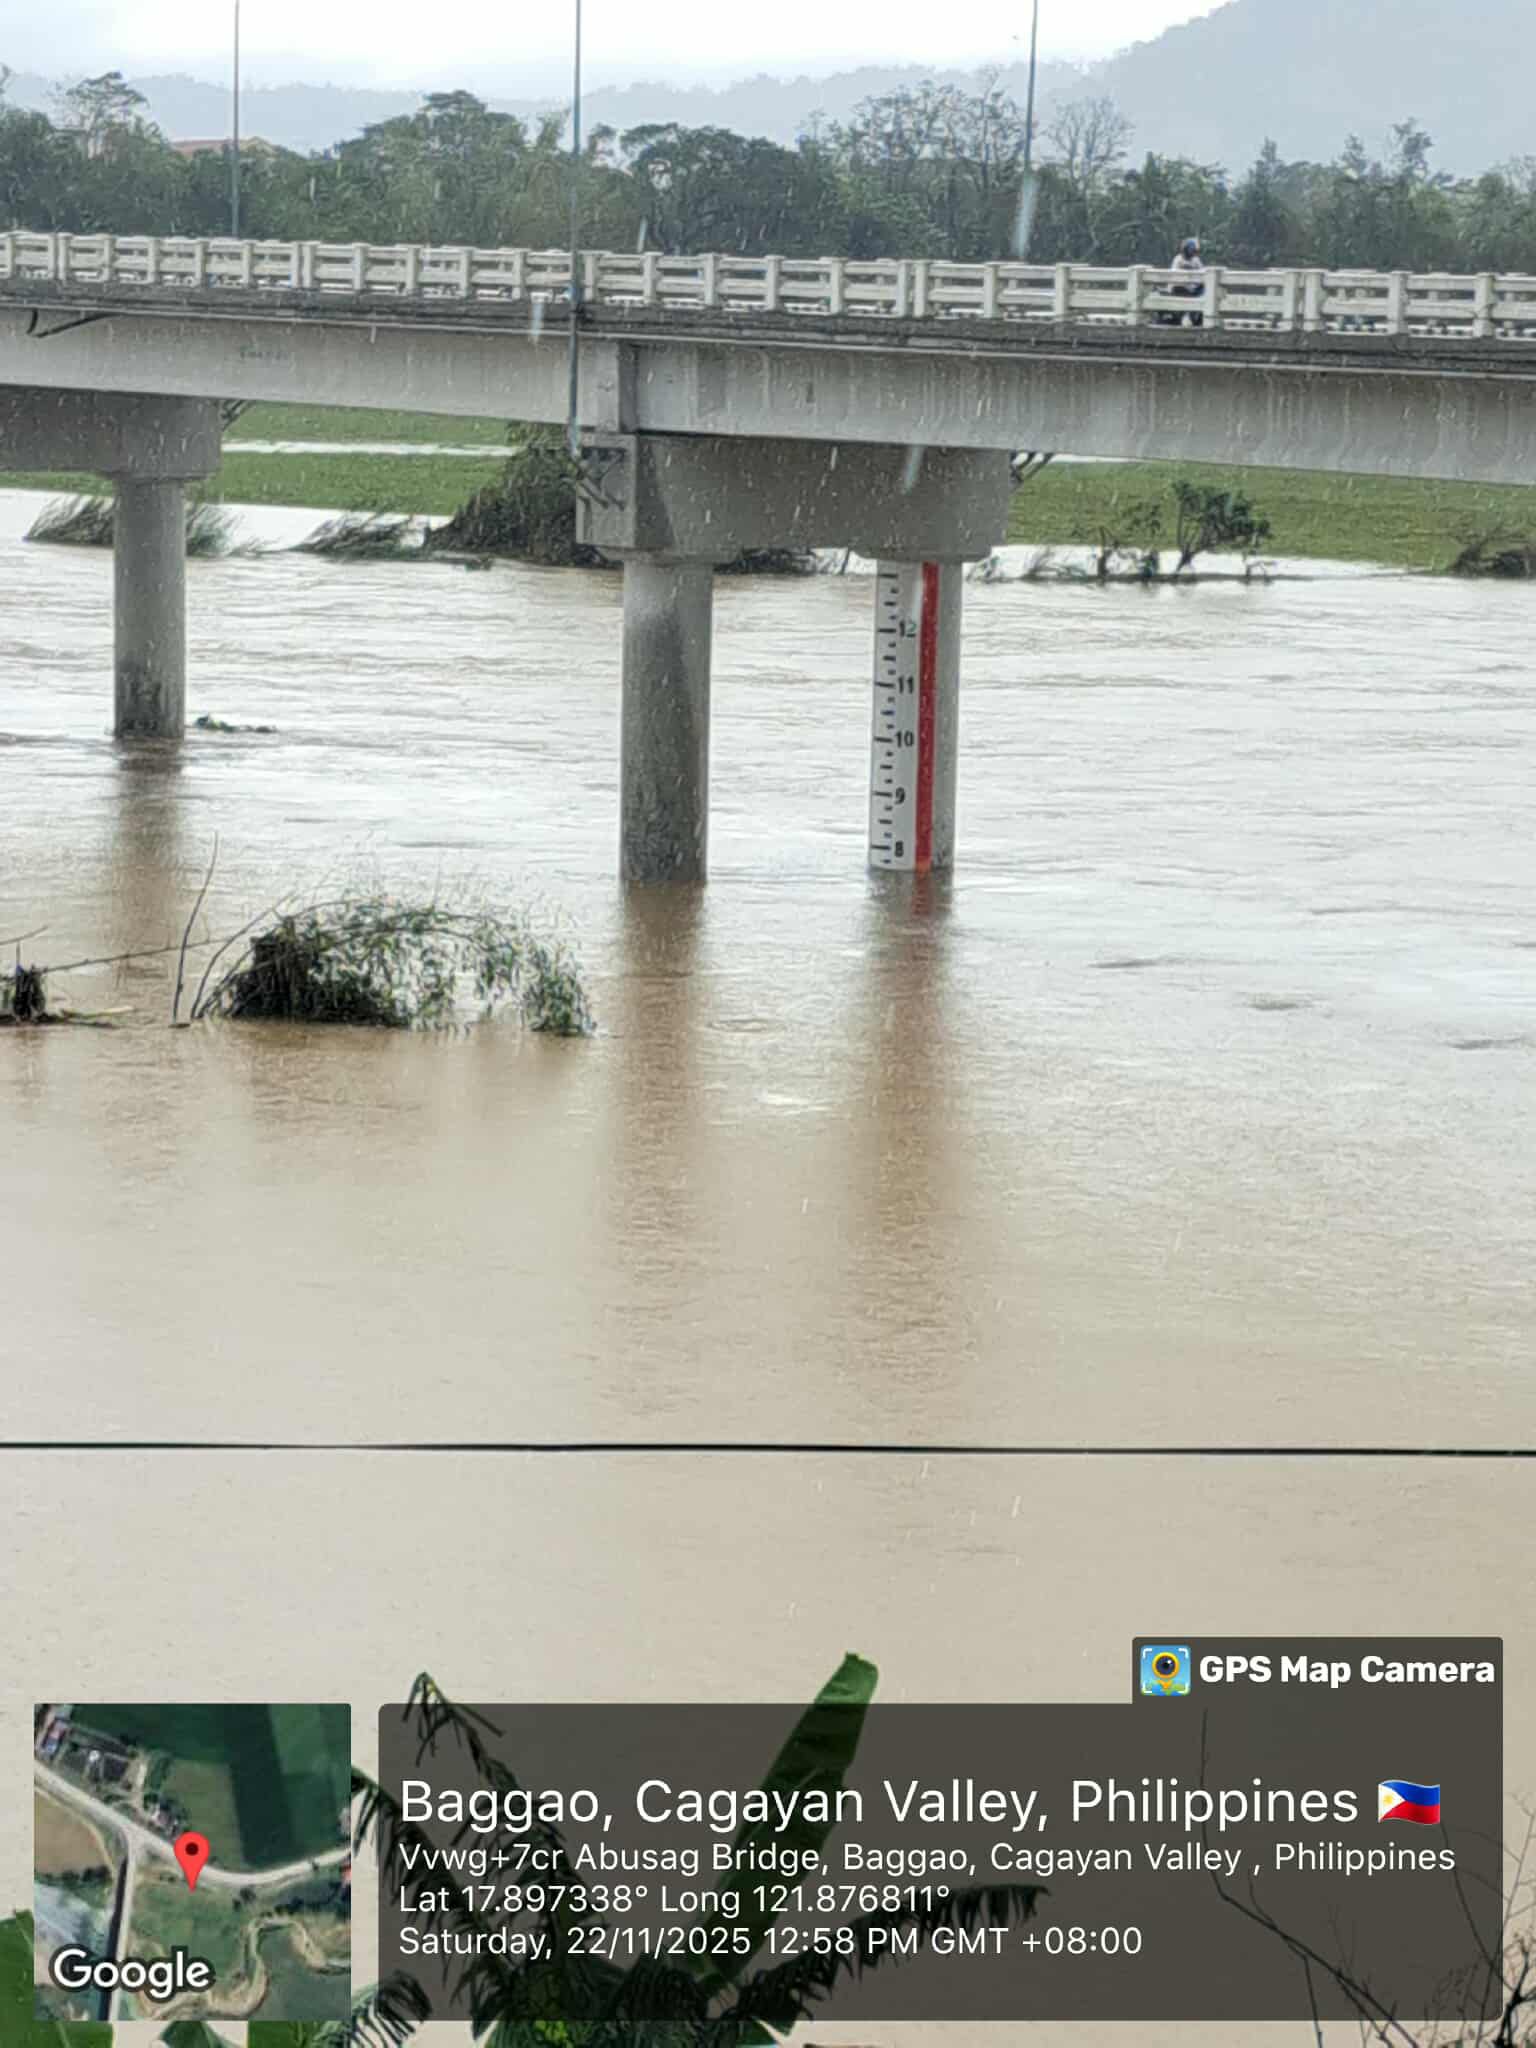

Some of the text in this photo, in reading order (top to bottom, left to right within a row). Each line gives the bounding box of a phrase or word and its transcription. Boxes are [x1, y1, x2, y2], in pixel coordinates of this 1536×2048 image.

[898, 621, 916, 637] 12
[897, 676, 914, 694] 11
[894, 730, 914, 748] 10
[895, 787, 905, 804] 9
[895, 841, 904, 857] 8
